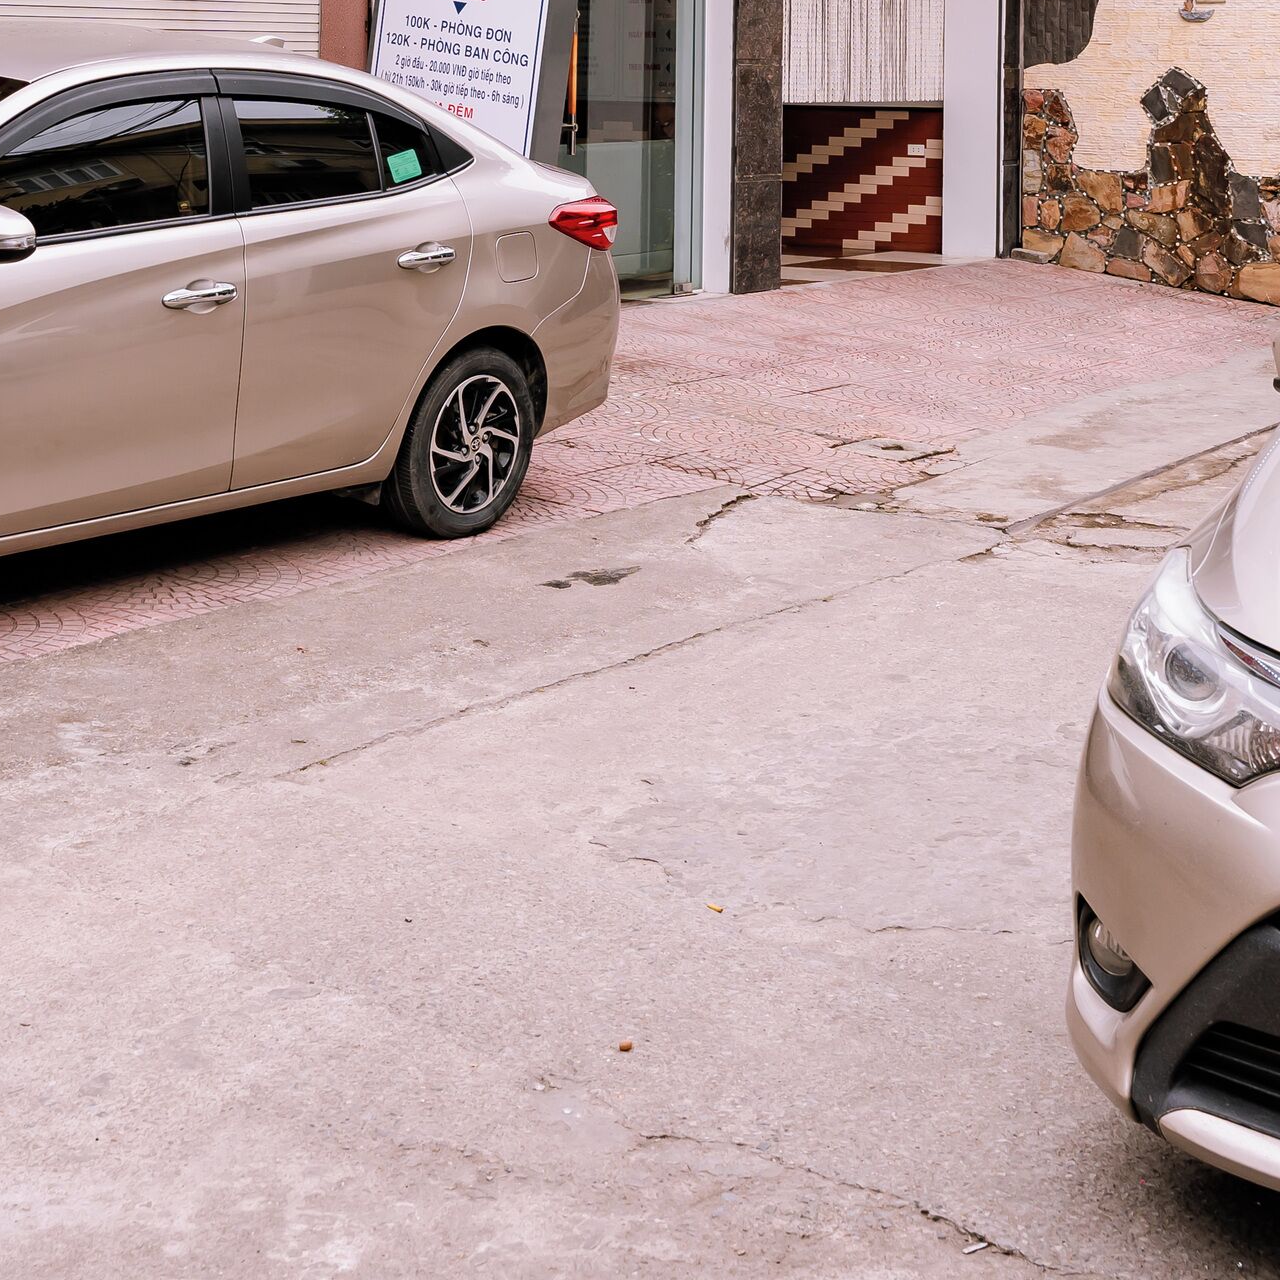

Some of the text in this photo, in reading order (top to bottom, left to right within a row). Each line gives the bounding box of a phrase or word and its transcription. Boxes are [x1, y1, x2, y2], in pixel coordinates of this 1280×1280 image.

[405, 14, 431, 30] 100K
[440, 19, 482, 39] PHÒNG
[485, 27, 512, 44] ĐƠN
[386, 32, 411, 47] 120K
[420, 37, 461, 56] PHÒNG
[464, 45, 489, 61] BAN
[493, 48, 529, 67] CÔNG
[395, 54, 400, 66] 2
[400, 55, 411, 70] giờ
[428, 61, 450, 75] 20.000
[452, 64, 467, 77] VNĐ
[468, 67, 480, 82] giờ
[480, 68, 493, 86] tiếp
[495, 72, 512, 85] theo
[392, 72, 403, 85] 21h
[430, 79, 442, 92] 30k
[443, 81, 455, 96] giờ
[455, 83, 468, 100] tiếp
[470, 86, 486, 100] theo
[491, 90, 501, 103] 6h
[502, 91, 520, 108] sáng
[447, 102, 474, 119] ĐÊM
